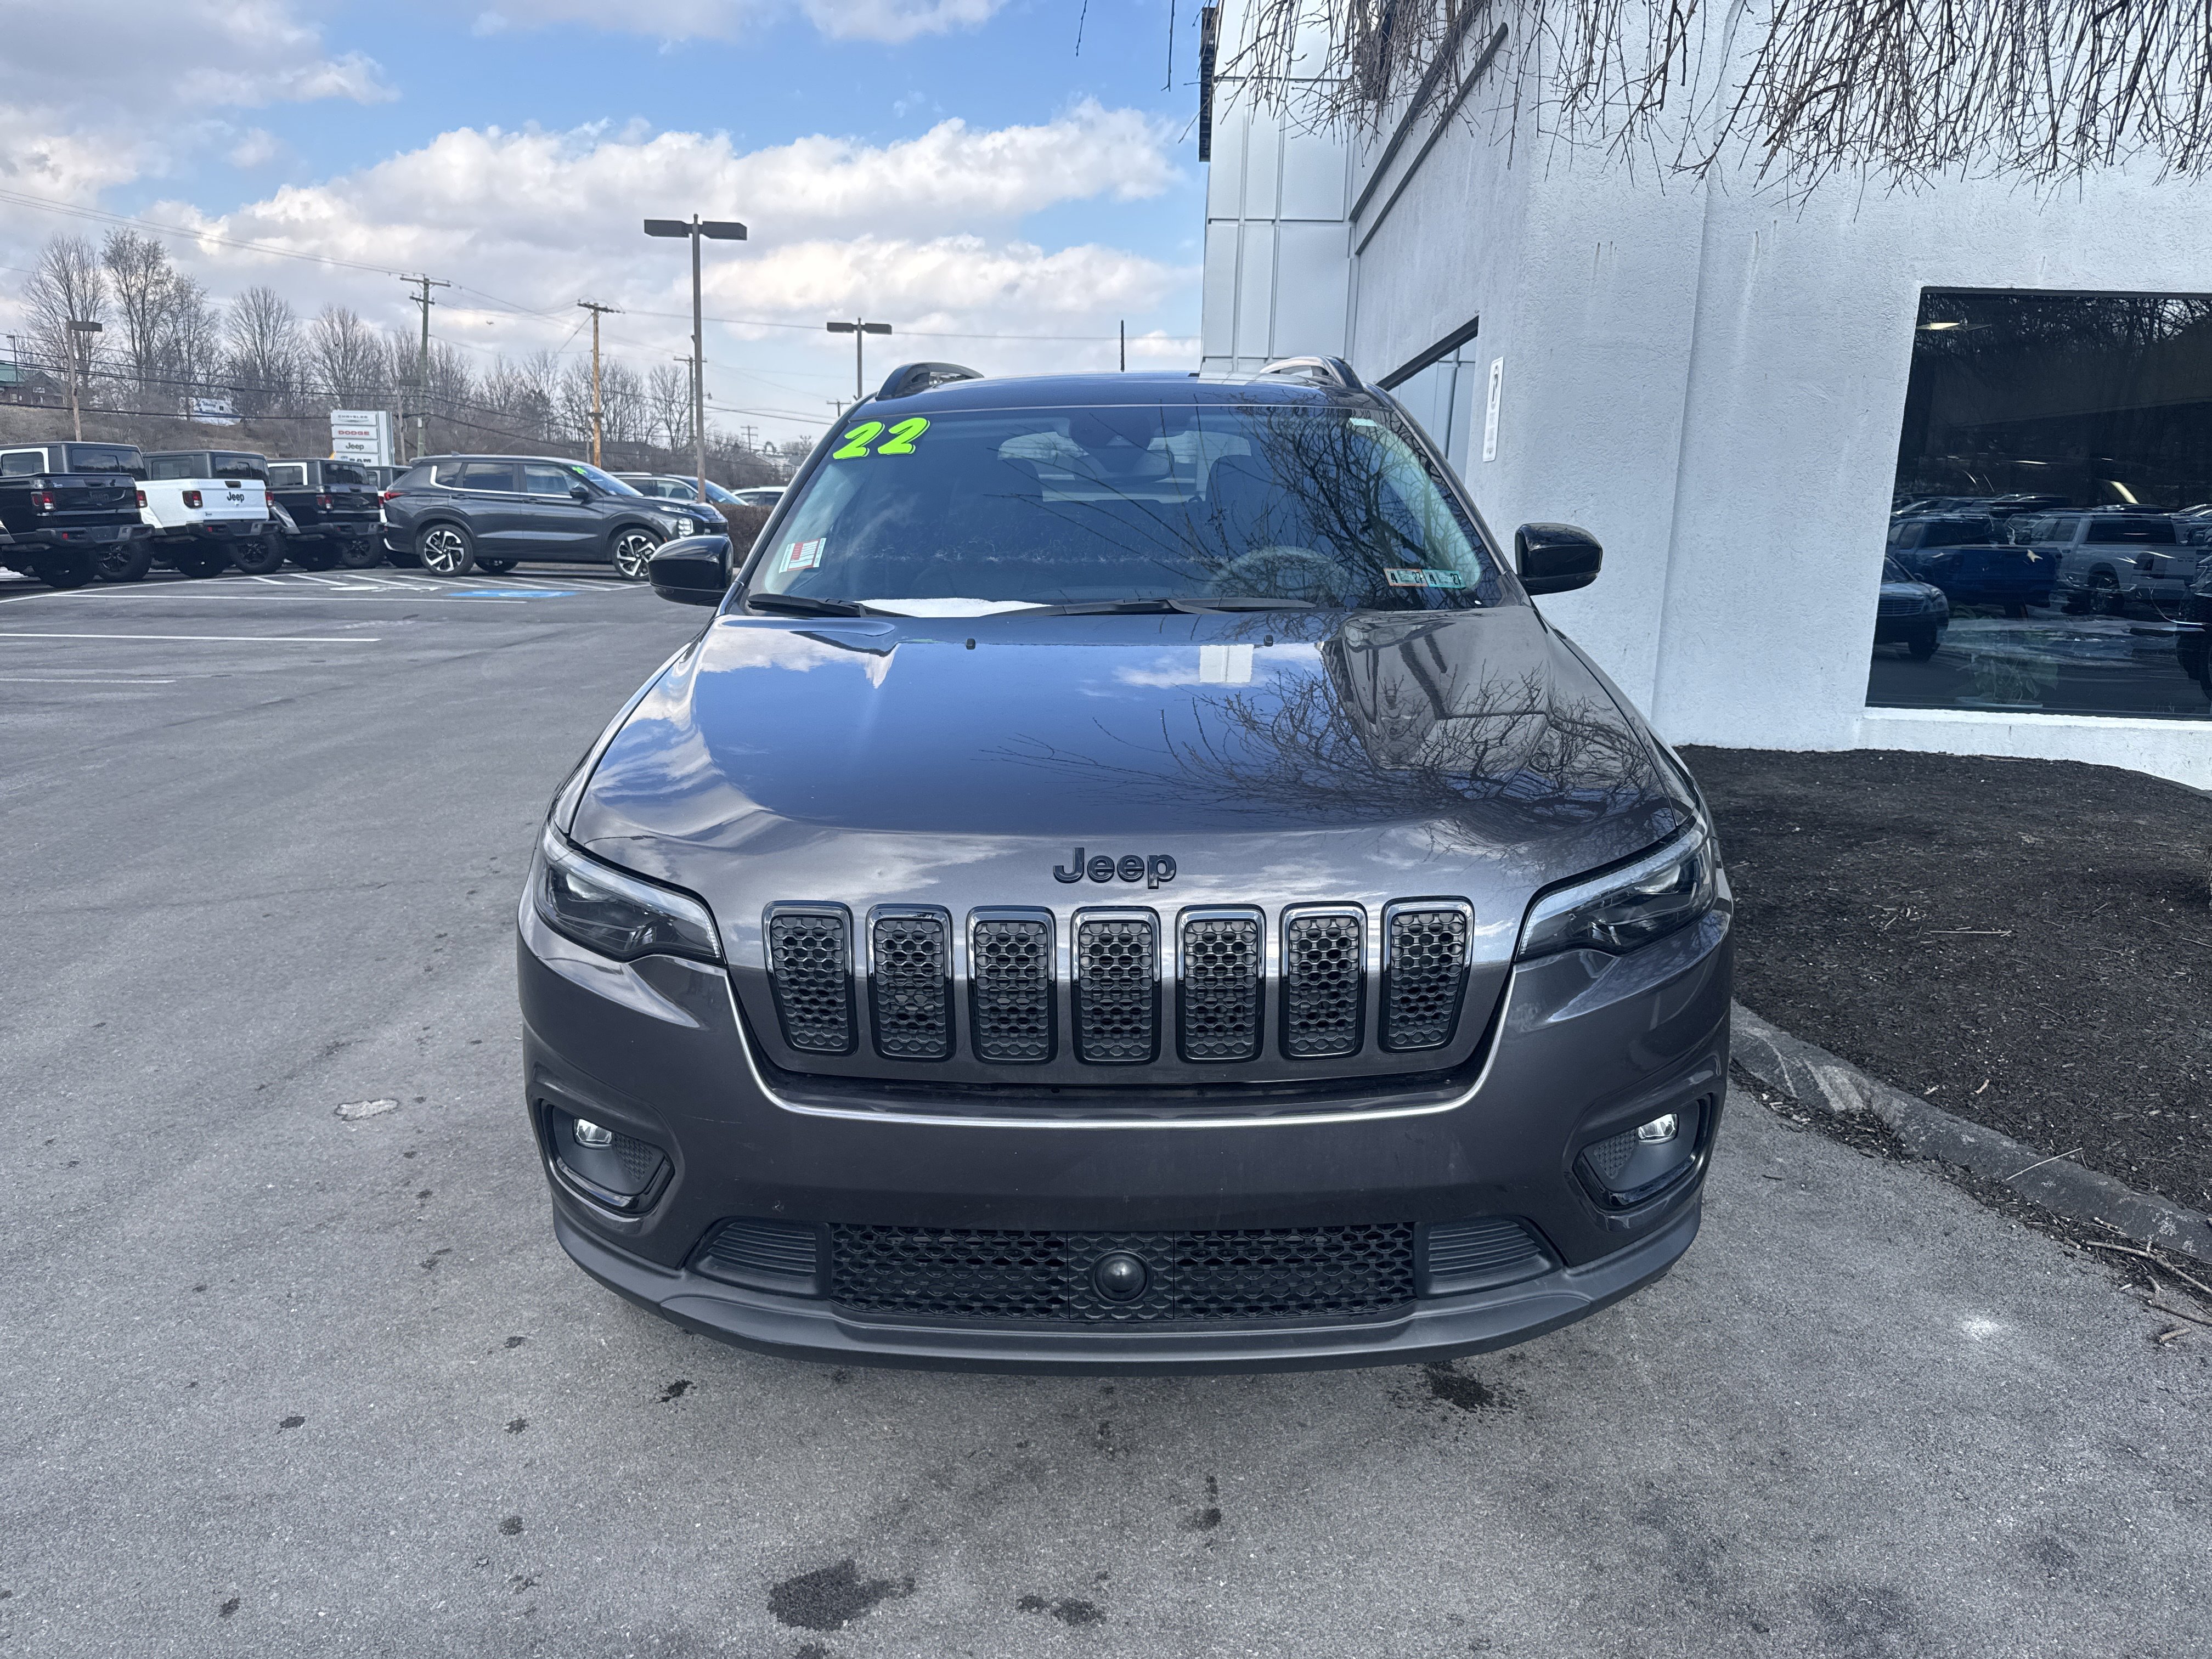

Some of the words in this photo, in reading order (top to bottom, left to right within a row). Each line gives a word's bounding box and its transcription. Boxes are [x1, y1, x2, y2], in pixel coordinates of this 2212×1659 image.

[833, 417, 930, 460] 22
[346, 442, 364, 450] Jeep
[227, 492, 245, 503] Jeep
[1390, 573, 1398, 584] 4
[1429, 574, 1437, 585] 4
[1053, 847, 1177, 890] Jeep
